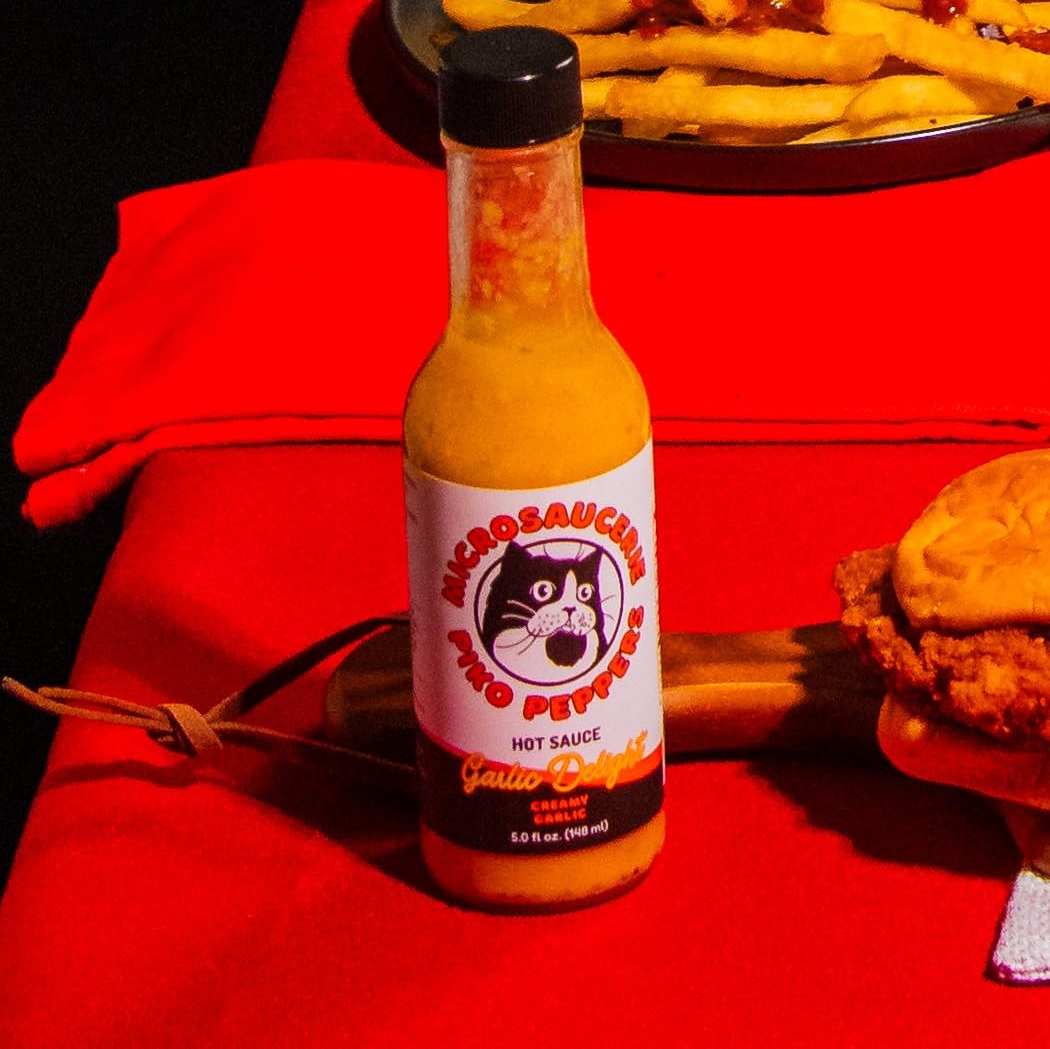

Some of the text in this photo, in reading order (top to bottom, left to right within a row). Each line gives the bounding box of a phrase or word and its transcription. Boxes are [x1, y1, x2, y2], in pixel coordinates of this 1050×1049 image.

[441, 500, 648, 610] MICROSAUCERIE
[447, 604, 646, 723] PIKO PEPPERS
[511, 727, 602, 753] HOT SAUCE
[461, 729, 650, 795] Garlic Delight
[529, 794, 590, 812] CREAMY
[533, 809, 587, 826] GARLIC
[510, 818, 609, 844] 5.0 fl oz. (148 ml)
